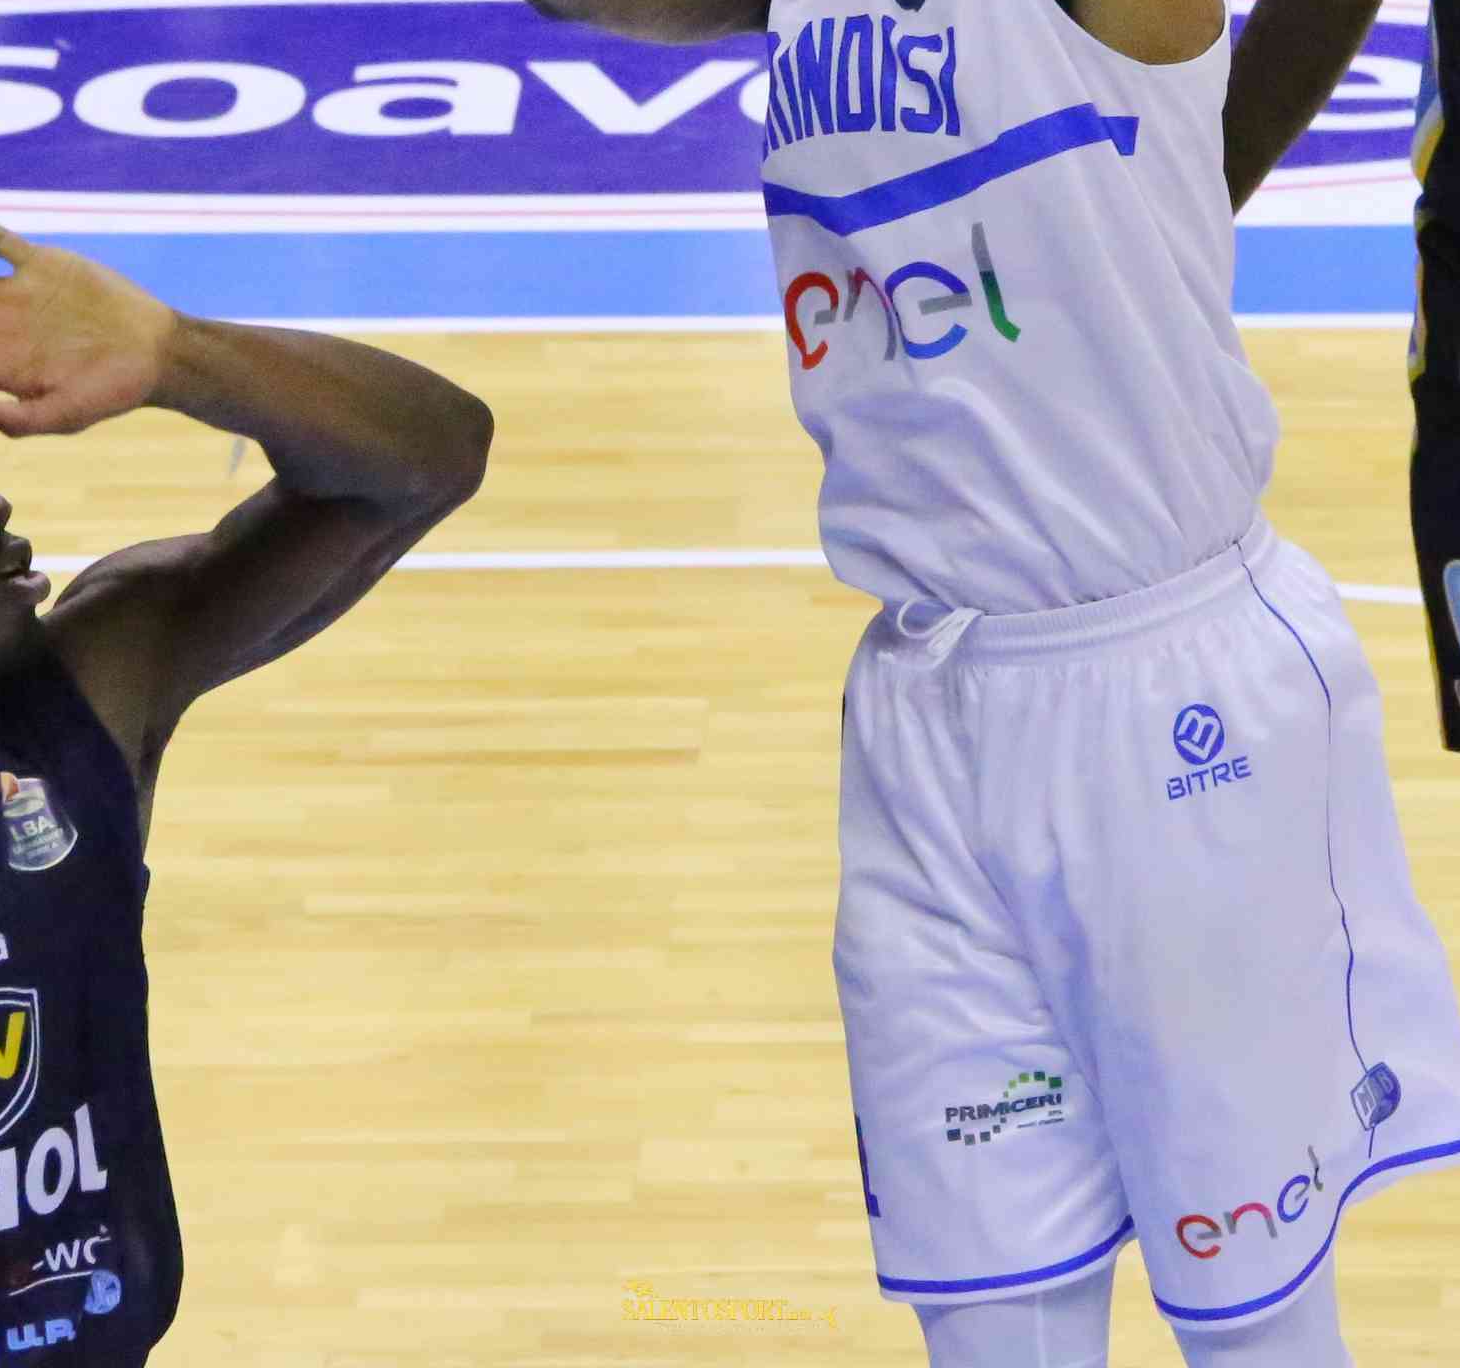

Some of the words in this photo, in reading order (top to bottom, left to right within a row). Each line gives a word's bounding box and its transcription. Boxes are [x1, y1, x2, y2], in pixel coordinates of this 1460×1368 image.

[784, 221, 1021, 370] enel
[1165, 756, 1253, 800] BITRE
[1176, 1144, 1325, 1260] enel
